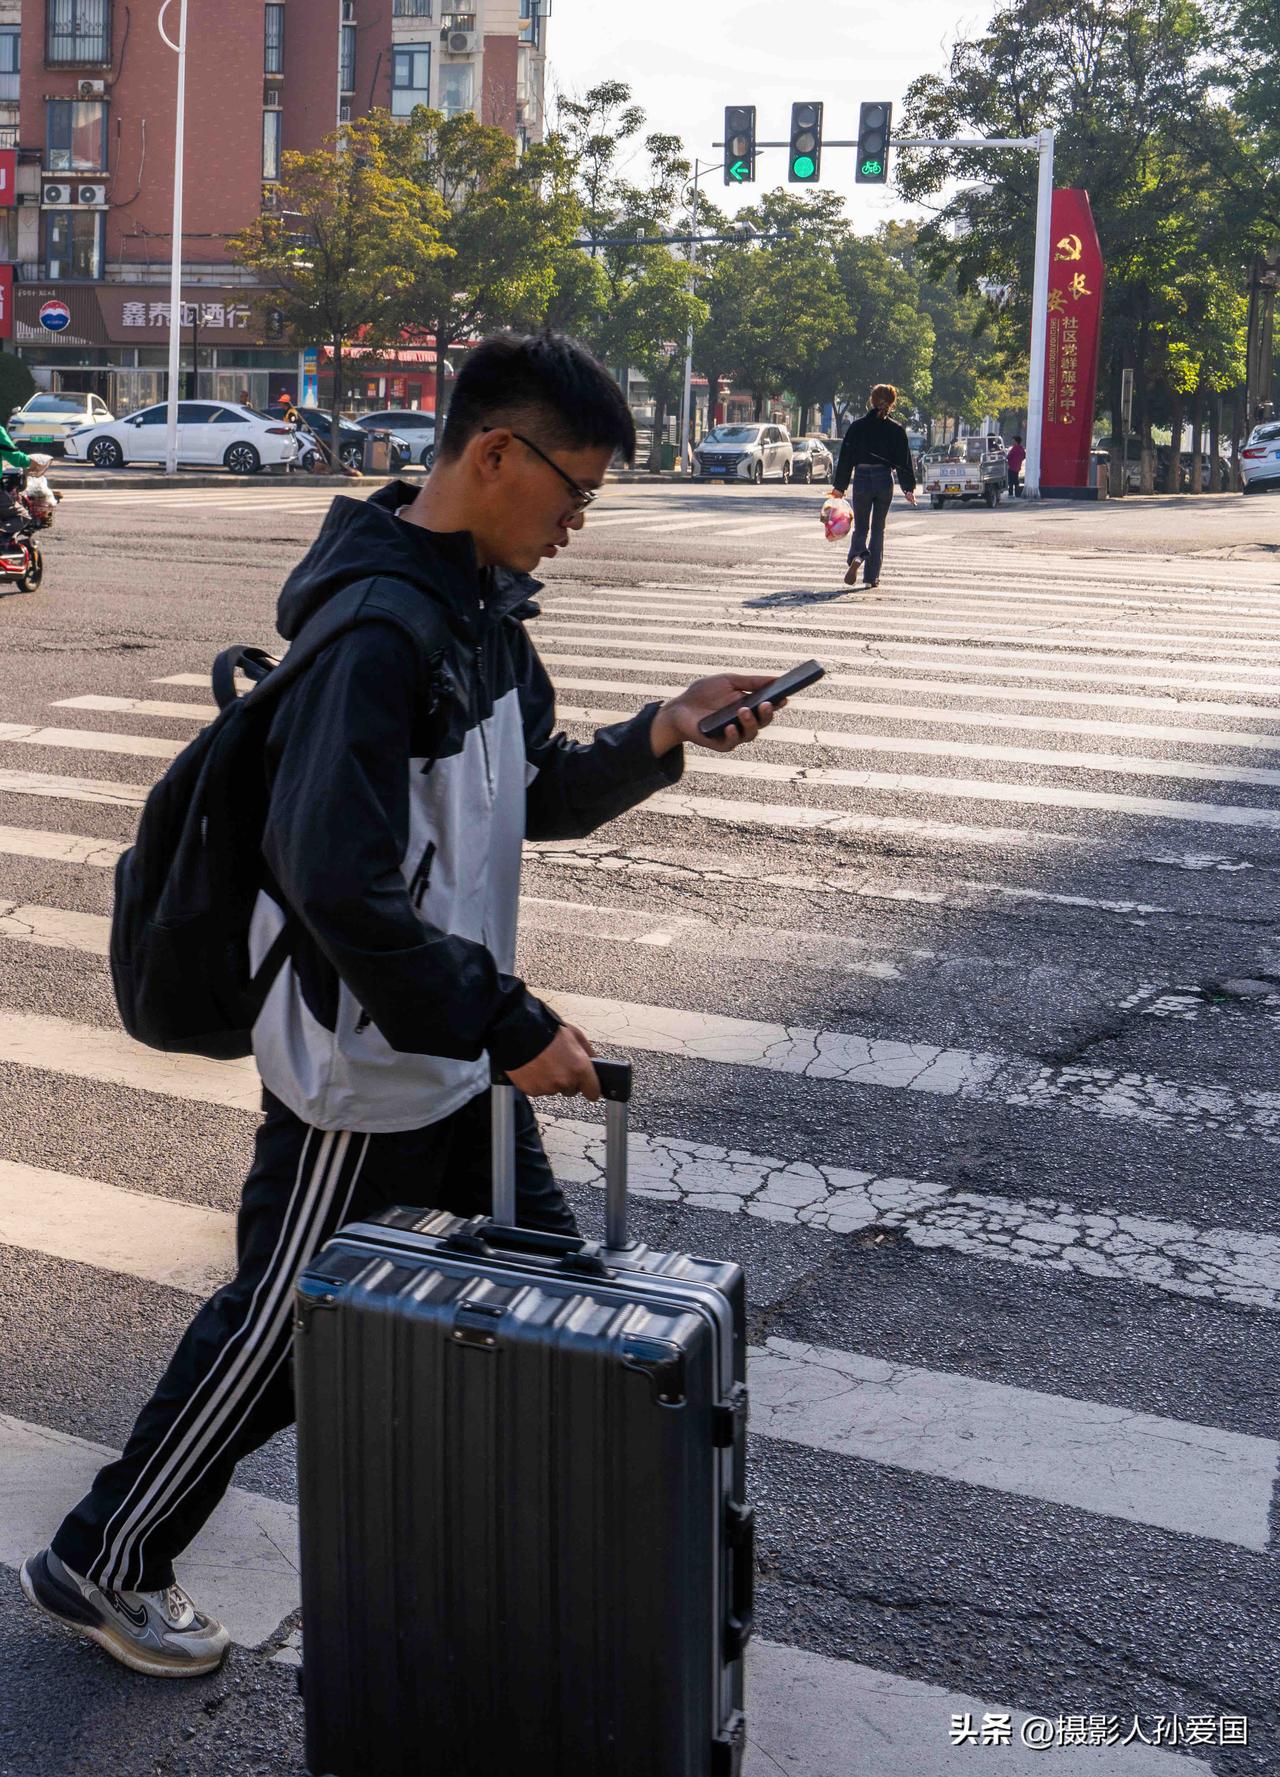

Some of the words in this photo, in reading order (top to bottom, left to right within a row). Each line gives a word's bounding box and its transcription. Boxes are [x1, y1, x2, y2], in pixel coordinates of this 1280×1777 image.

[1060, 316, 1079, 424] 社区党群服务中心
